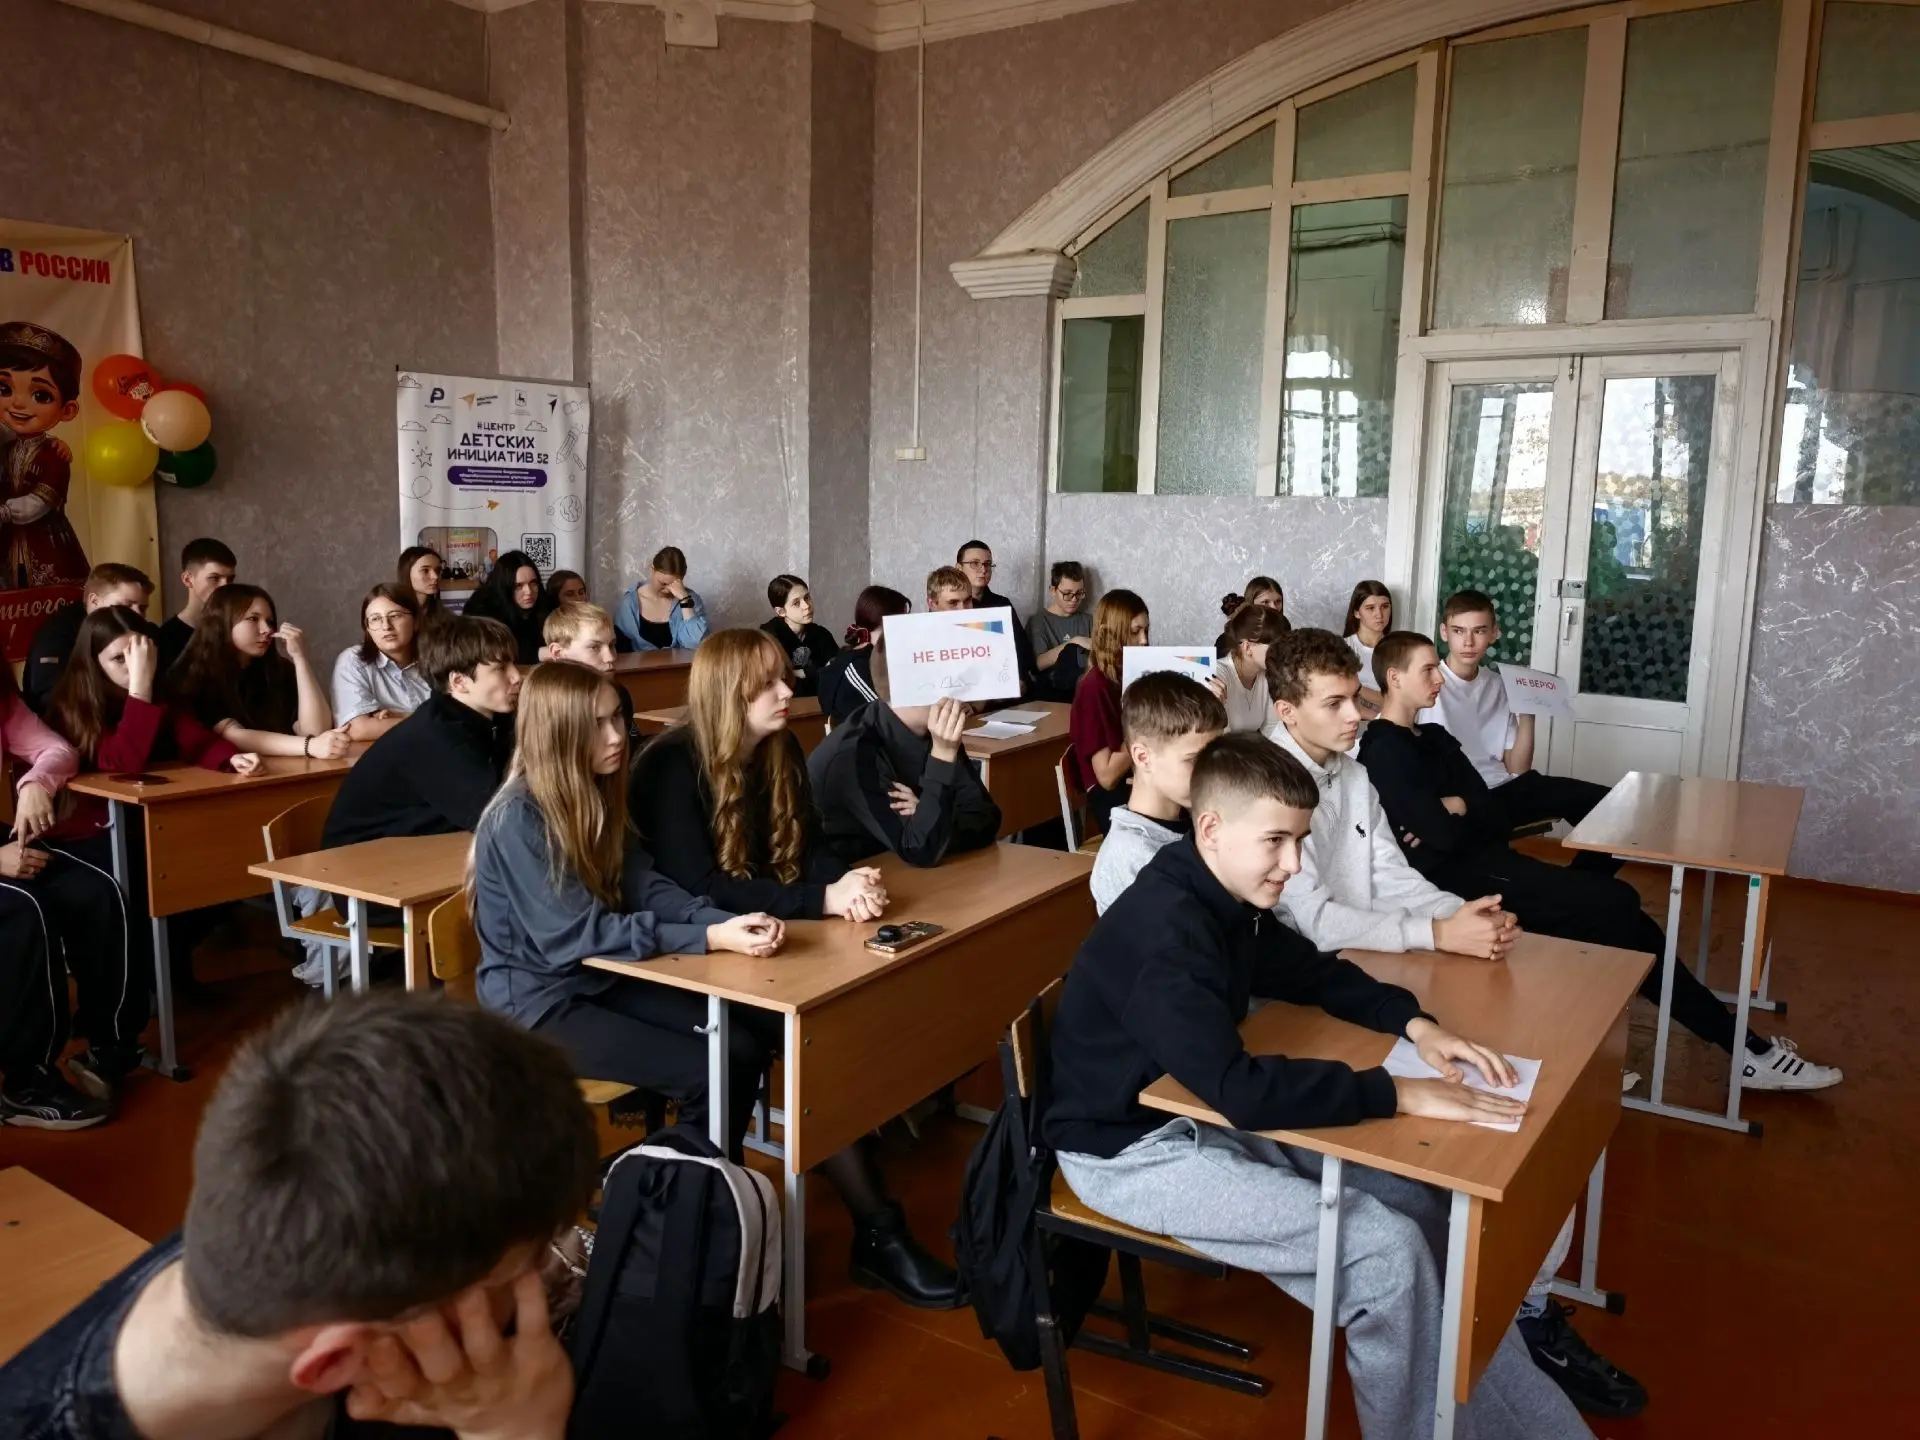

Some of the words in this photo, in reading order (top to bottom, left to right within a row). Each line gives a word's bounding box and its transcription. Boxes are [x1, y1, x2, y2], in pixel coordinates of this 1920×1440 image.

[20, 250, 110, 284] РОССИИ
[477, 421, 515, 431] #ЦЕНТР
[460, 433, 535, 448] ДЕТСКИХ
[448, 449, 534, 463] ИНИЦИАТИВ
[537, 453, 549, 464] 52
[913, 650, 935, 663] НЕ
[940, 645, 991, 661] ВЕРЮ!
[1516, 677, 1528, 686] НЕ
